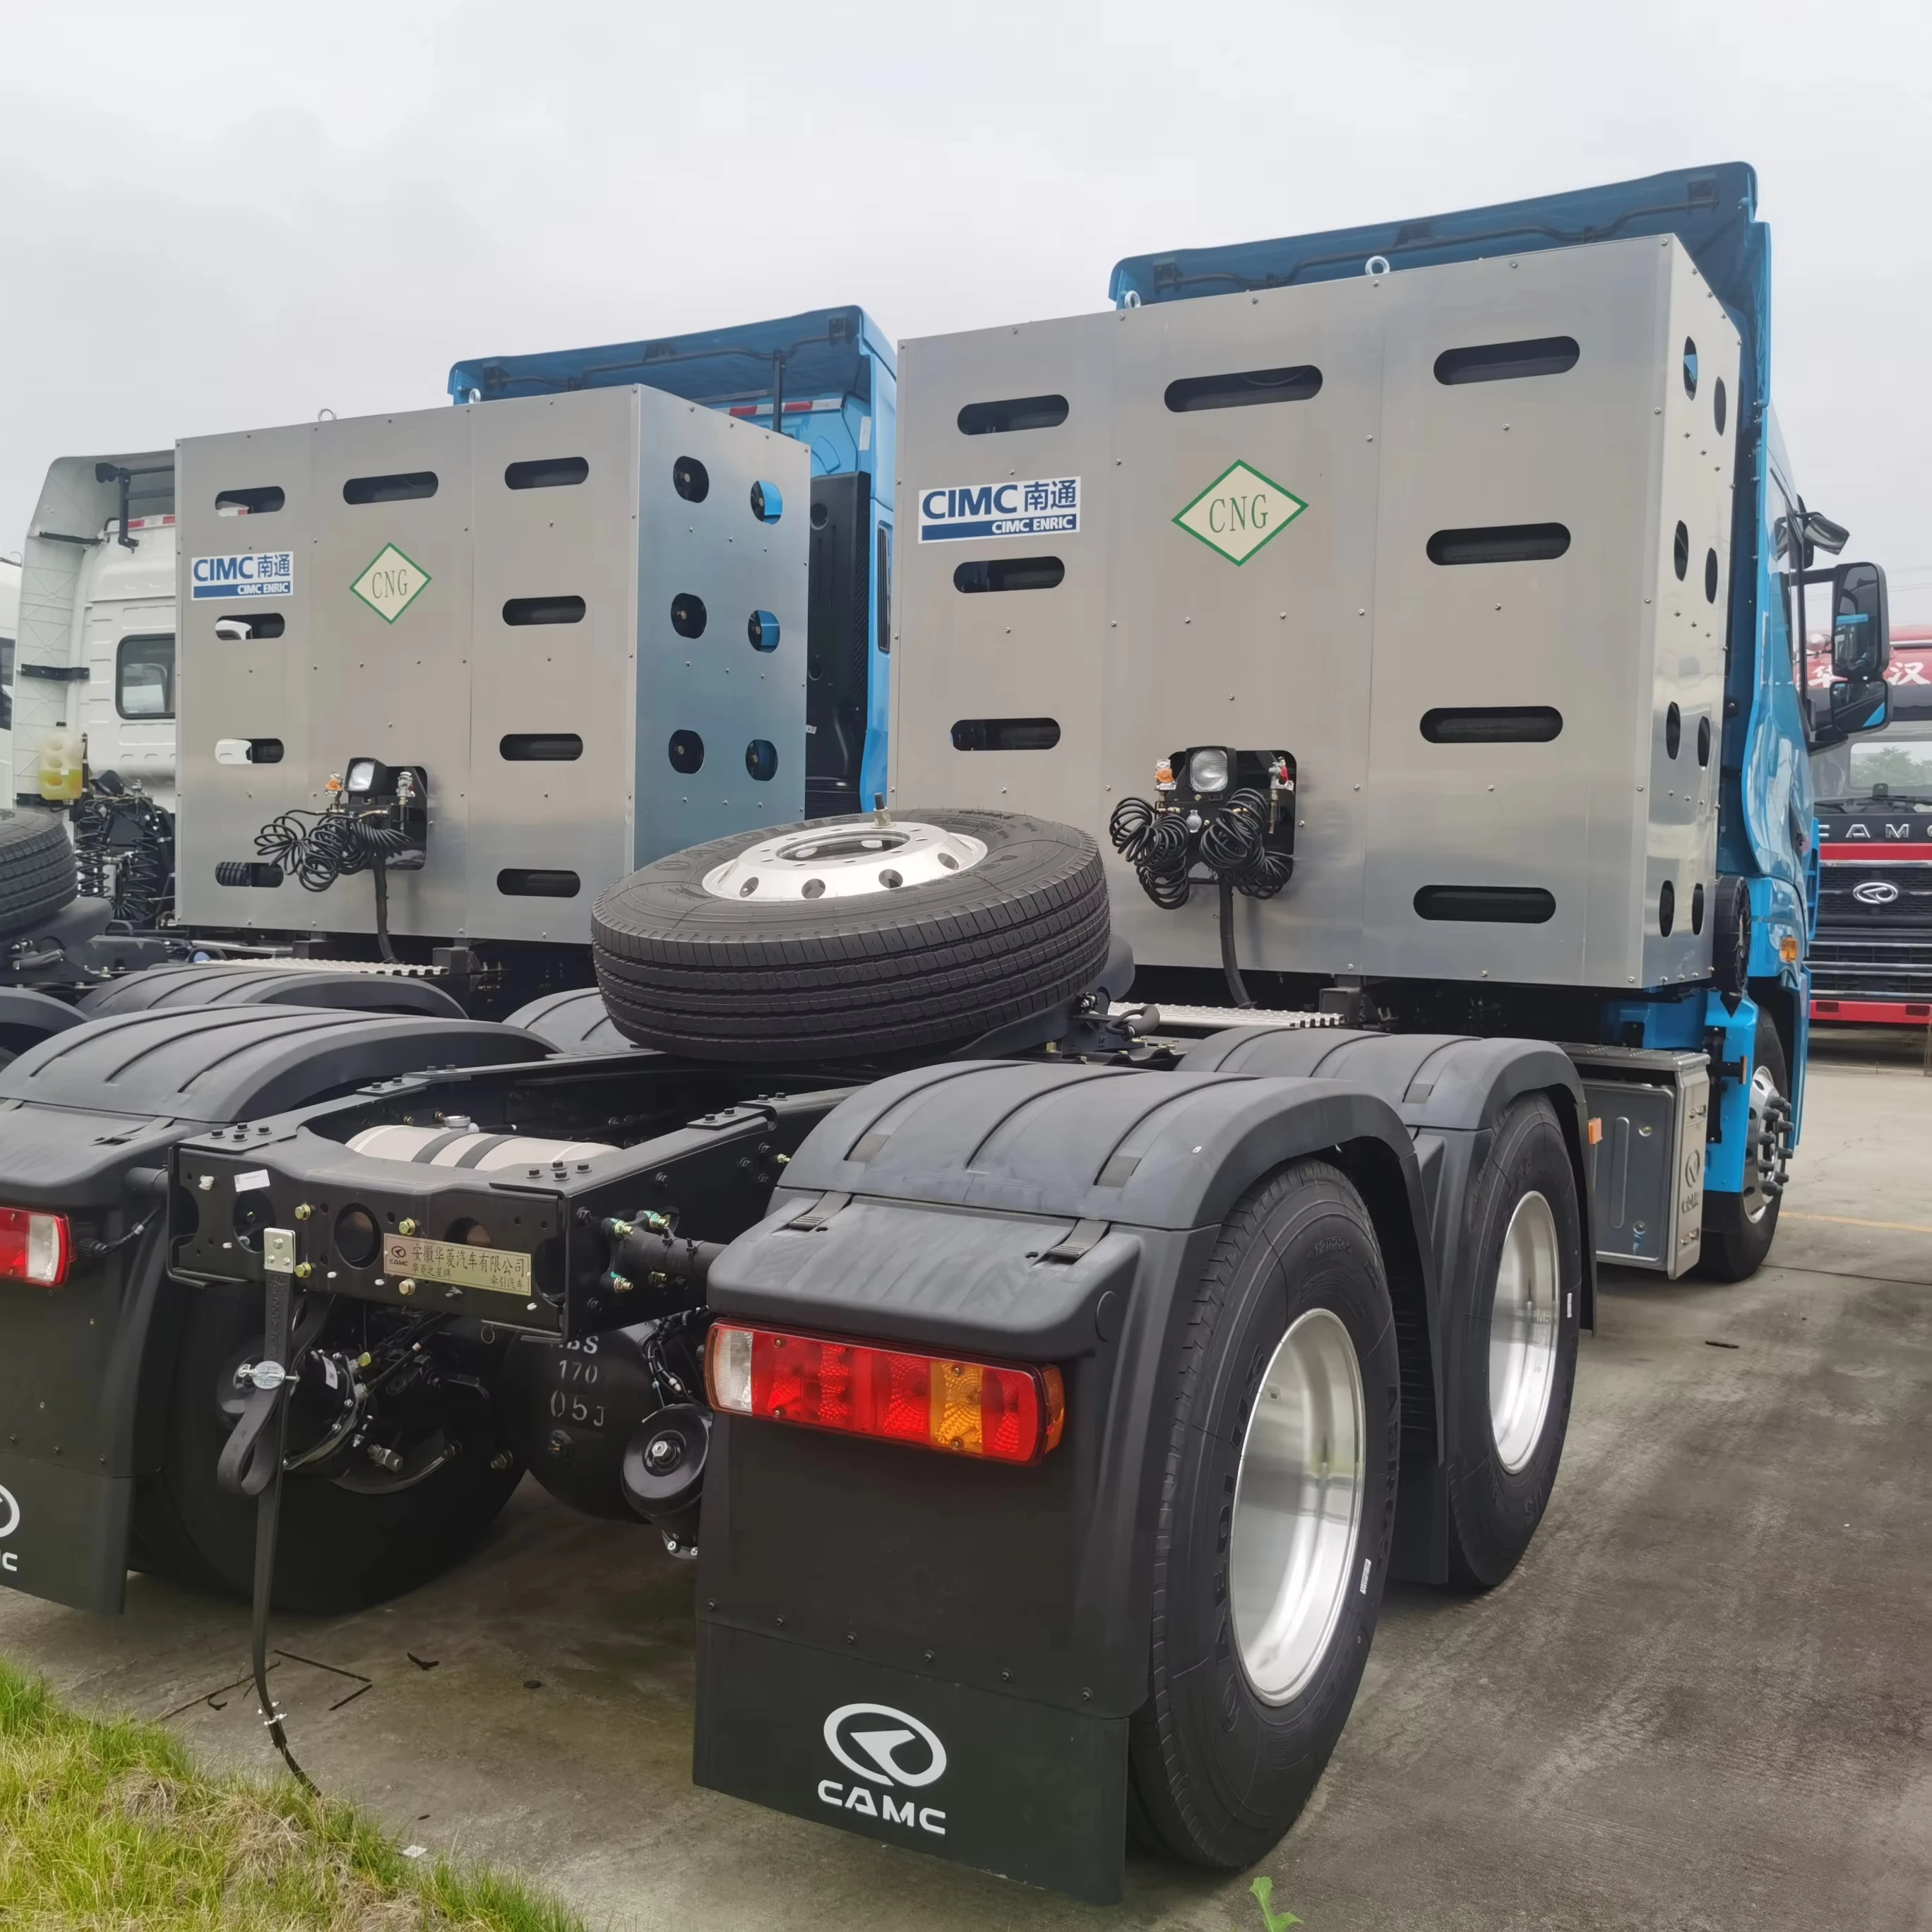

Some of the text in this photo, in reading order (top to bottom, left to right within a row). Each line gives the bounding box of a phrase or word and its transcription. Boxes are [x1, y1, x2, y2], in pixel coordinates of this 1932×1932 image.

[922, 479, 1077, 520] CIMC 南通
[1209, 494, 1268, 533] CNG
[991, 515, 1073, 534] CIMC ENRIC
[193, 554, 291, 582] CIMC 南通
[237, 583, 289, 595] CIMC ENRIC
[372, 568, 408, 599] CNG
[412, 1244, 525, 1277] 安徽华菱汽车有限公司
[490, 1276, 524, 1290] 牵引汽车
[559, 1359, 598, 1384] 170
[818, 1779, 946, 1835] CAMC
